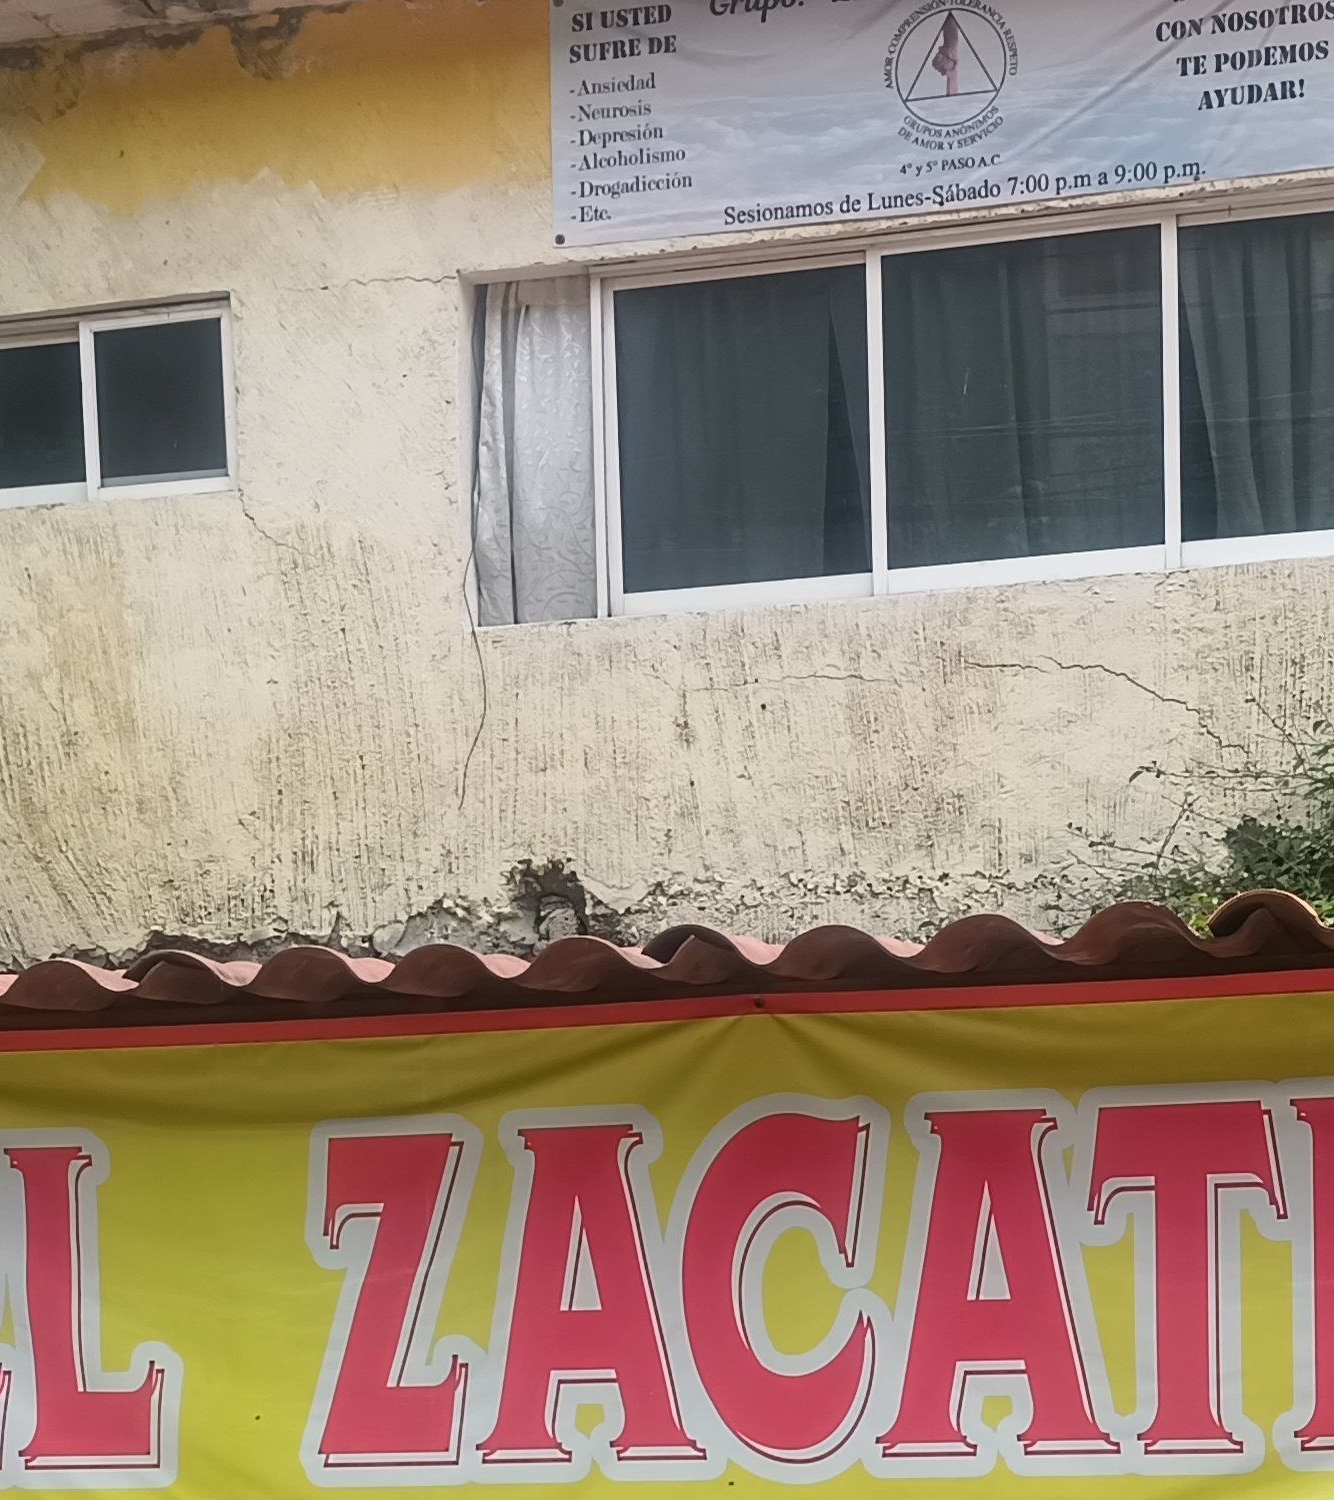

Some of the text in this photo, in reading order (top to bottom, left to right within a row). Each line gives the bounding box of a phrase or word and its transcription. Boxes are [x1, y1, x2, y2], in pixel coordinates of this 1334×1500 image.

[571, 4, 672, 32] SI USTED
[1155, 17, 1203, 42] CON
[569, 34, 677, 64] SUFRE DE
[883, 57, 894, 89] AMOR
[1003, 28, 1018, 76] RESPETO
[1176, 40, 1329, 77] TE PODEMOS
[1198, 78, 1305, 111] AYUDAR!
[898, 116, 1004, 151] DE AMOR Y SERVICIO
[903, 115, 942, 138] GRUPOS
[915, 164, 923, 177] y
[941, 156, 976, 171] PASO
[724, 200, 834, 226] Sesionamos
[839, 194, 861, 214] de
[1007, 173, 1049, 196] 7:00
[1097, 171, 1108, 186] a
[1115, 161, 1158, 185] 9:00
[1163, 161, 1206, 184] p.m.
